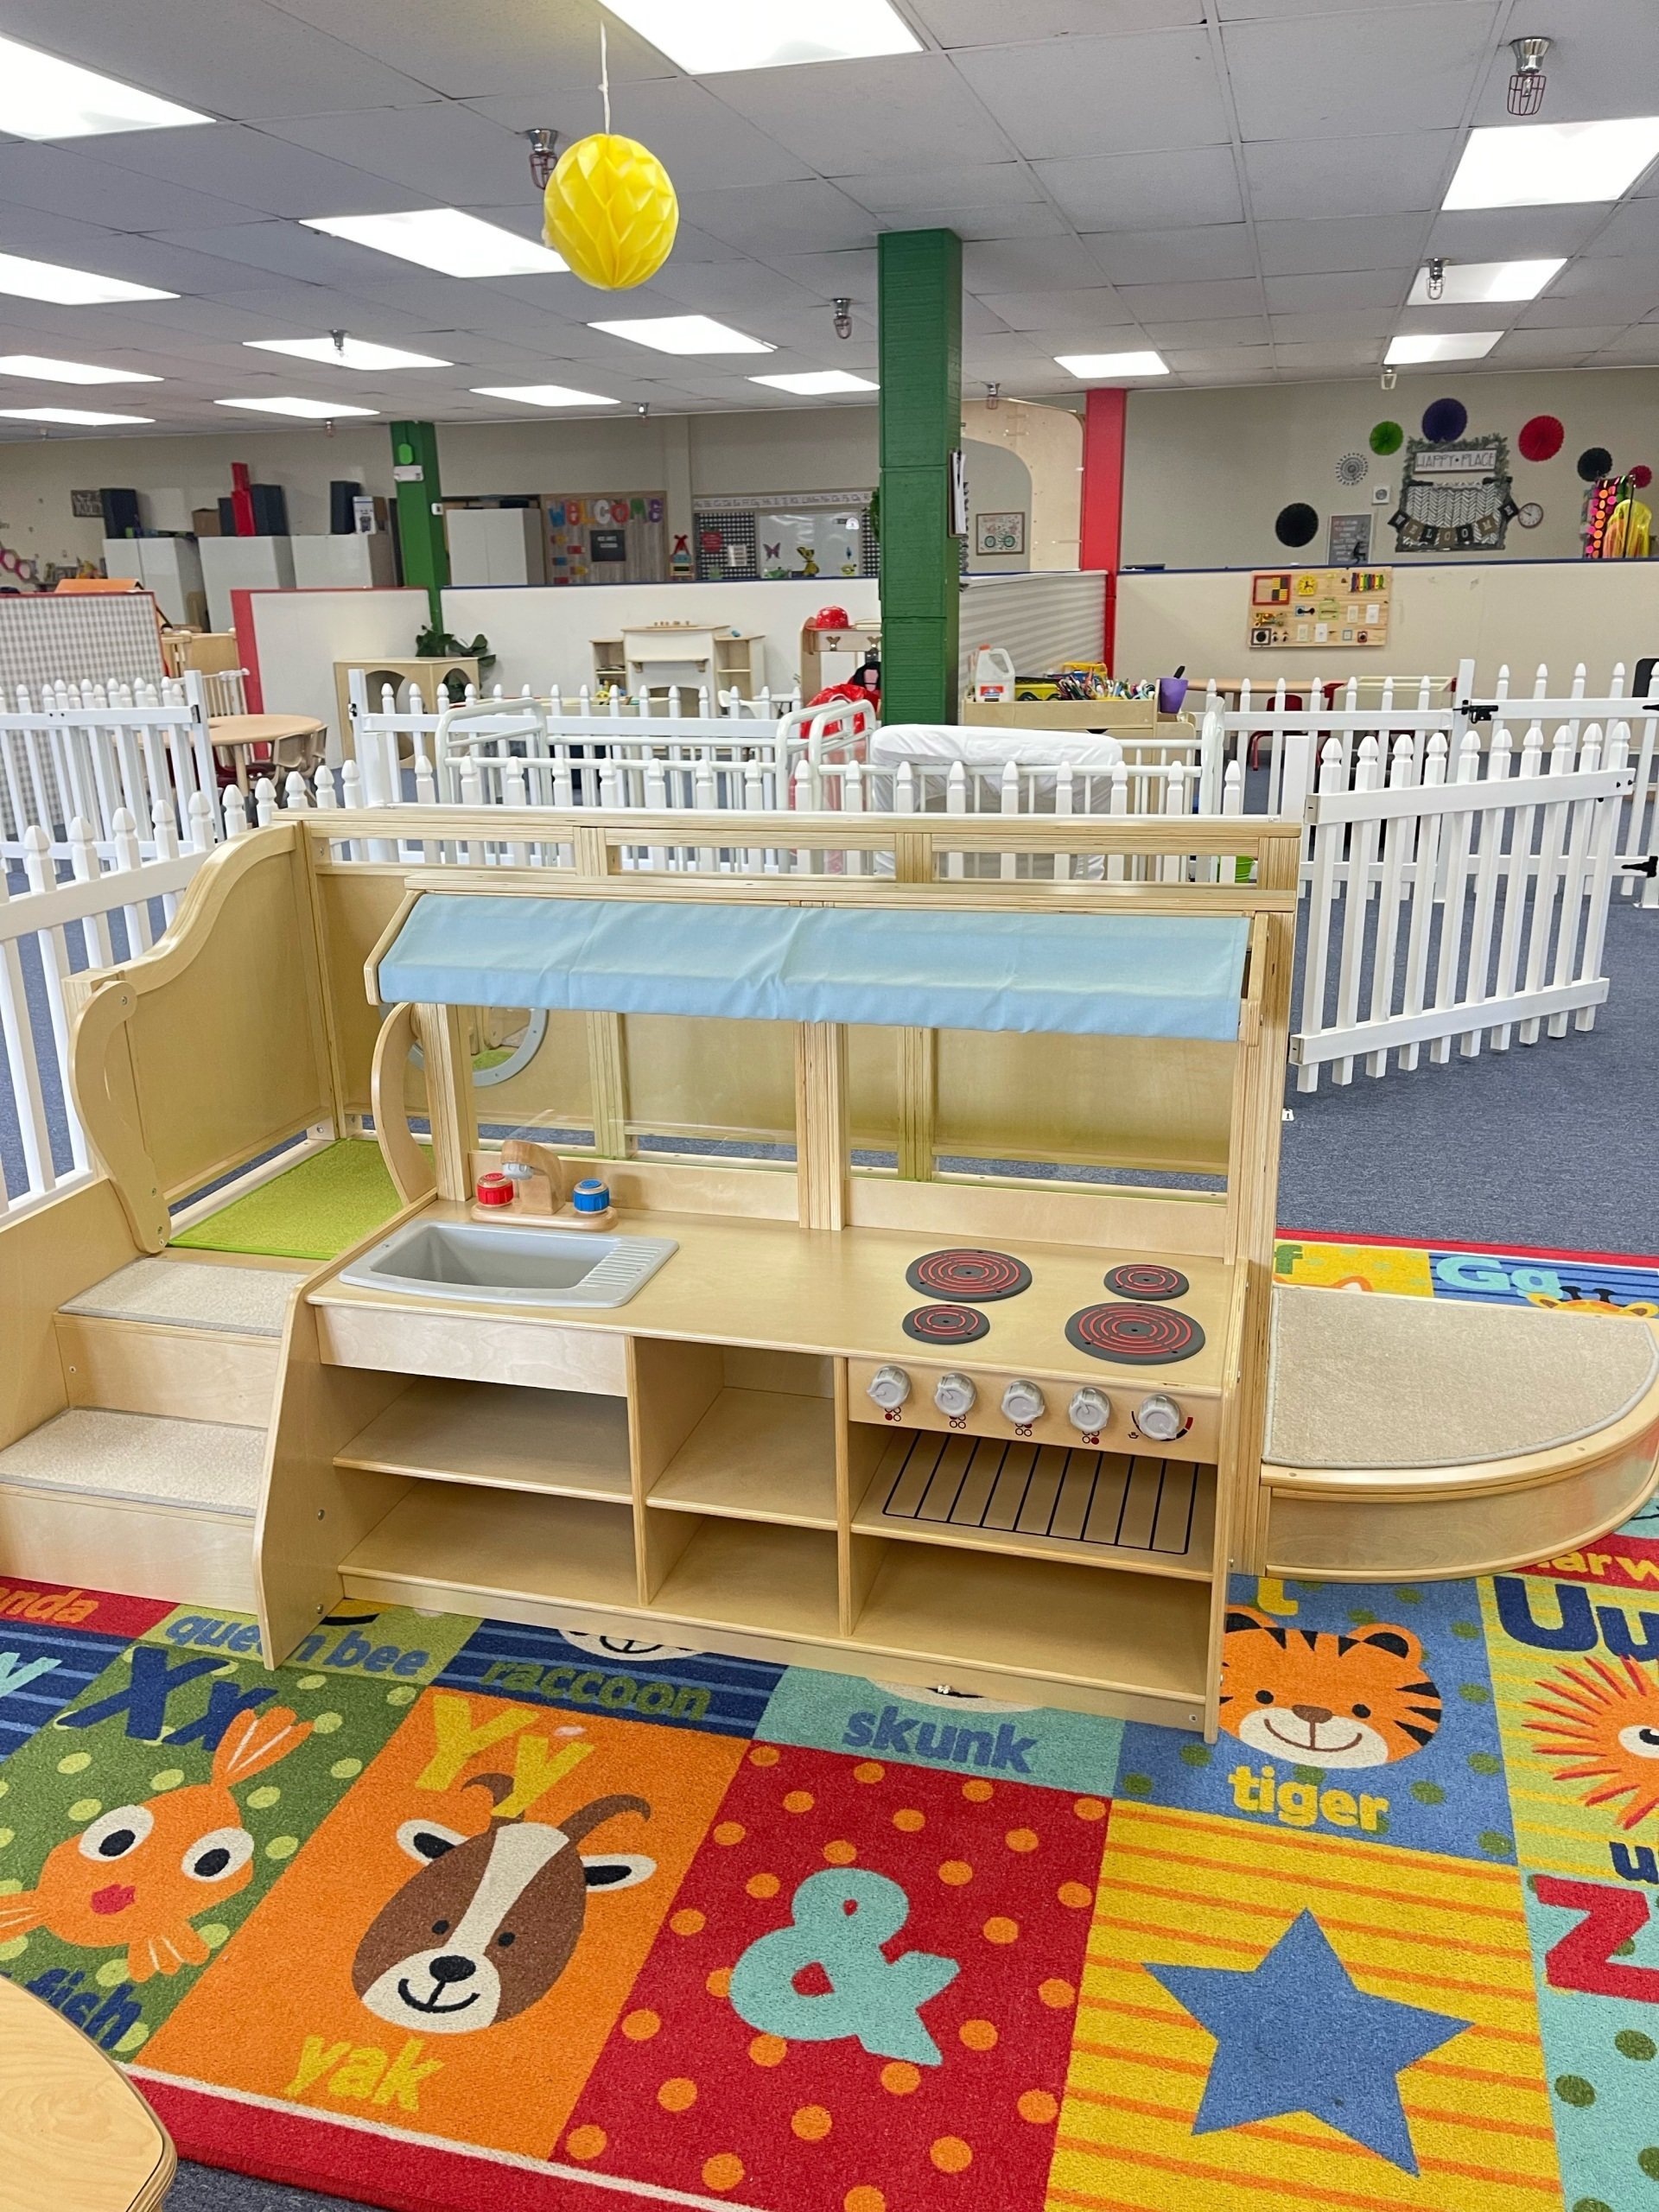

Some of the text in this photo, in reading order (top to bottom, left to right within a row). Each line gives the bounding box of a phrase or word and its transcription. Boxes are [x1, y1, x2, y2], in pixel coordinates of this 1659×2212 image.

[1460, 452, 1496, 467] PLACE
[549, 498, 664, 528] WELCOME
[0, 1586, 99, 1624] nda
[1493, 1575, 1659, 1662] Uu
[323, 1630, 430, 1676] bee
[55, 1646, 278, 1752] Xx
[480, 1660, 712, 1721] raccoon
[415, 1694, 595, 1819] Yy
[841, 1706, 1039, 1775] skunk
[1227, 1764, 1390, 1831] tiger
[284, 2032, 447, 2113] yak
